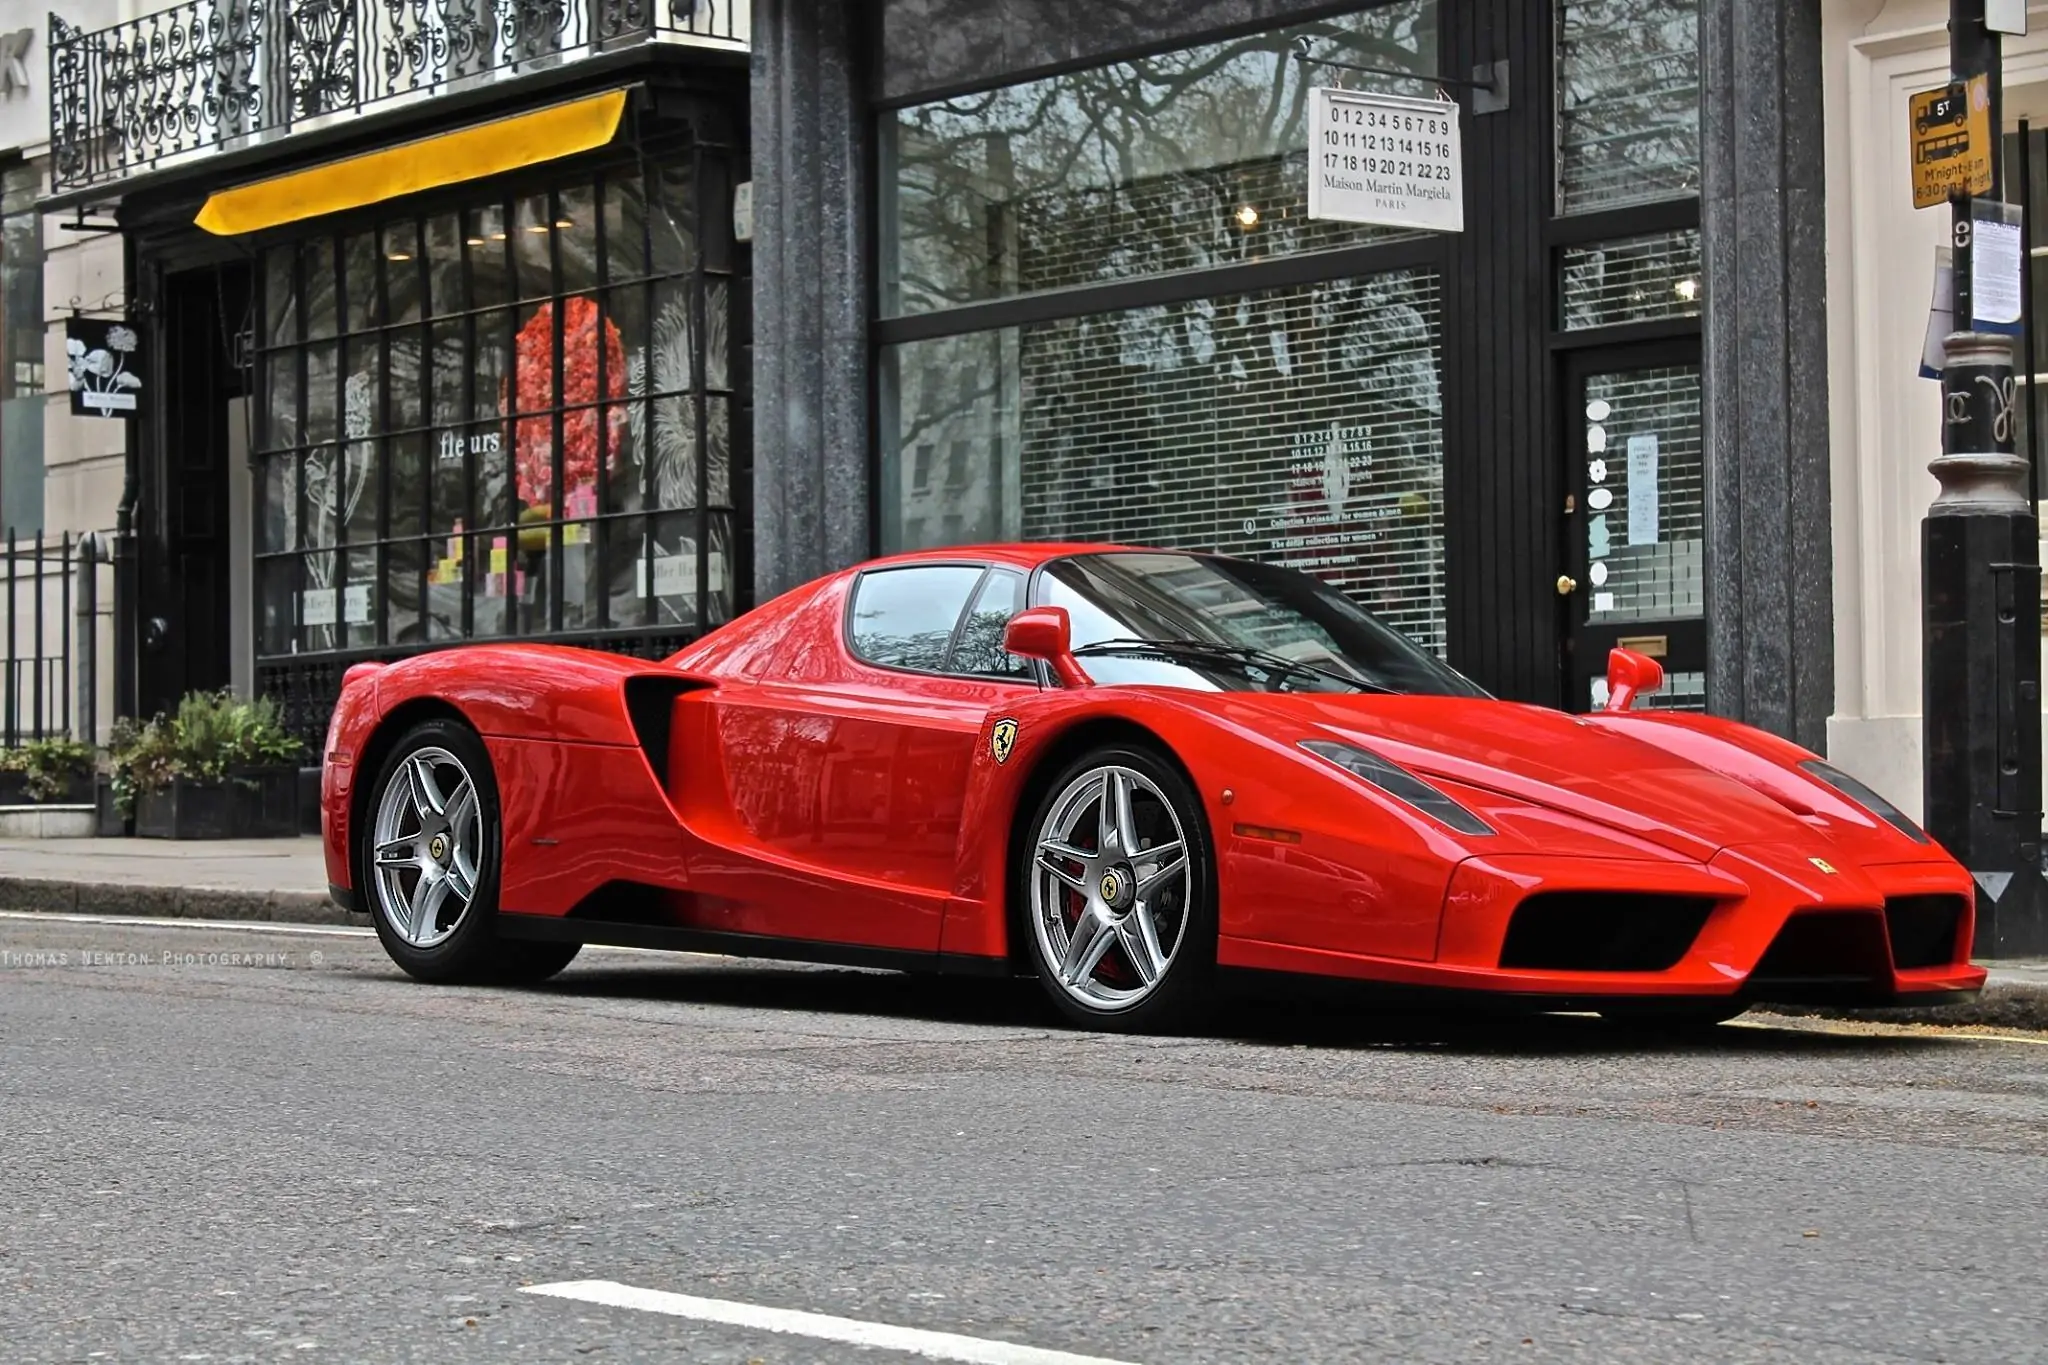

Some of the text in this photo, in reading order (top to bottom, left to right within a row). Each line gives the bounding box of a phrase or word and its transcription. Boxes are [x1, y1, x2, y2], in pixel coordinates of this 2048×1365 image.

[1331, 107, 1449, 135] 0 1 2 3 4 5 6 7 8 9
[1324, 130, 1450, 158] 10 11 12 13 14 15 16
[1324, 153, 1450, 181] 17 18 19 20 21 22 23
[1324, 174, 1451, 201] Maison Martin Margiela
[1375, 198, 1407, 210] PARIS
